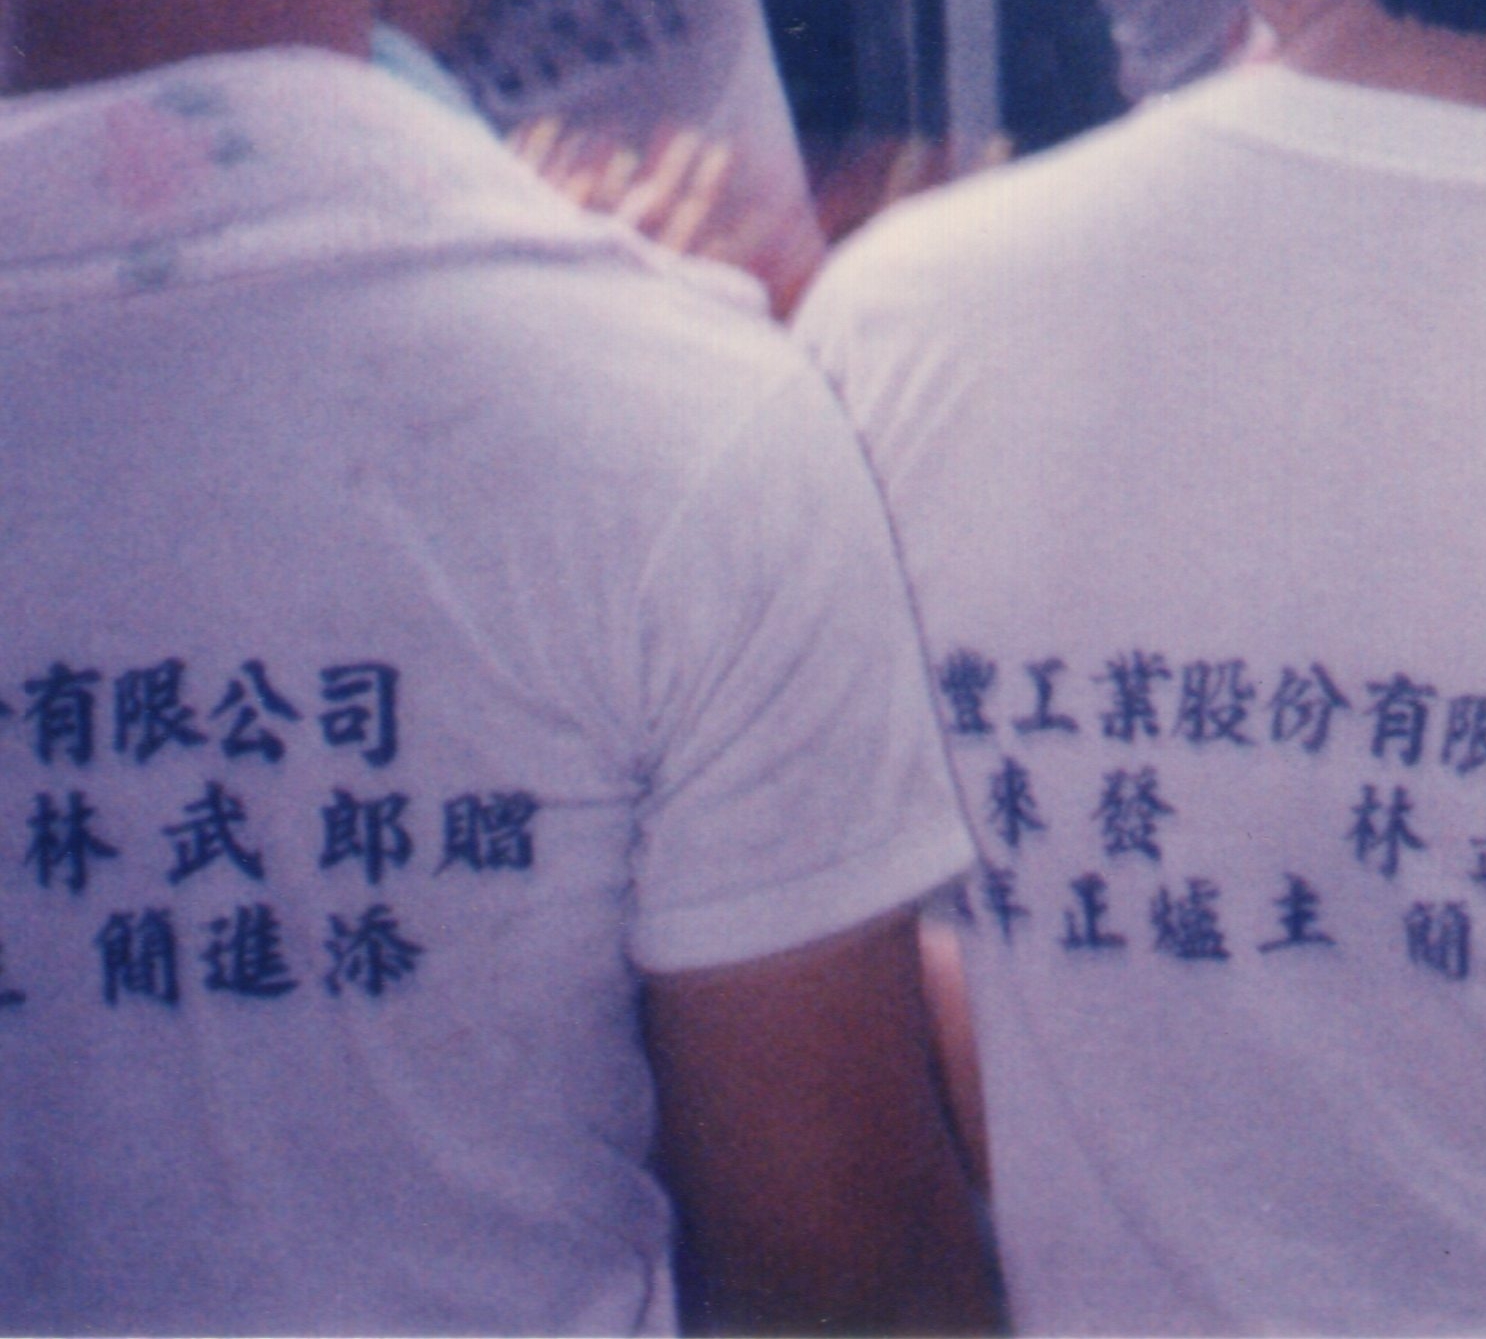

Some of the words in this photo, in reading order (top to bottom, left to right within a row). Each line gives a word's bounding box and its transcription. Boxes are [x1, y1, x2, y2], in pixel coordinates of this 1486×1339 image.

[0, 656, 403, 768] 有限公司
[20, 780, 546, 898] 林武郎贈
[94, 900, 428, 1010] 簡進添
[952, 870, 1340, 964] 年正爐主
